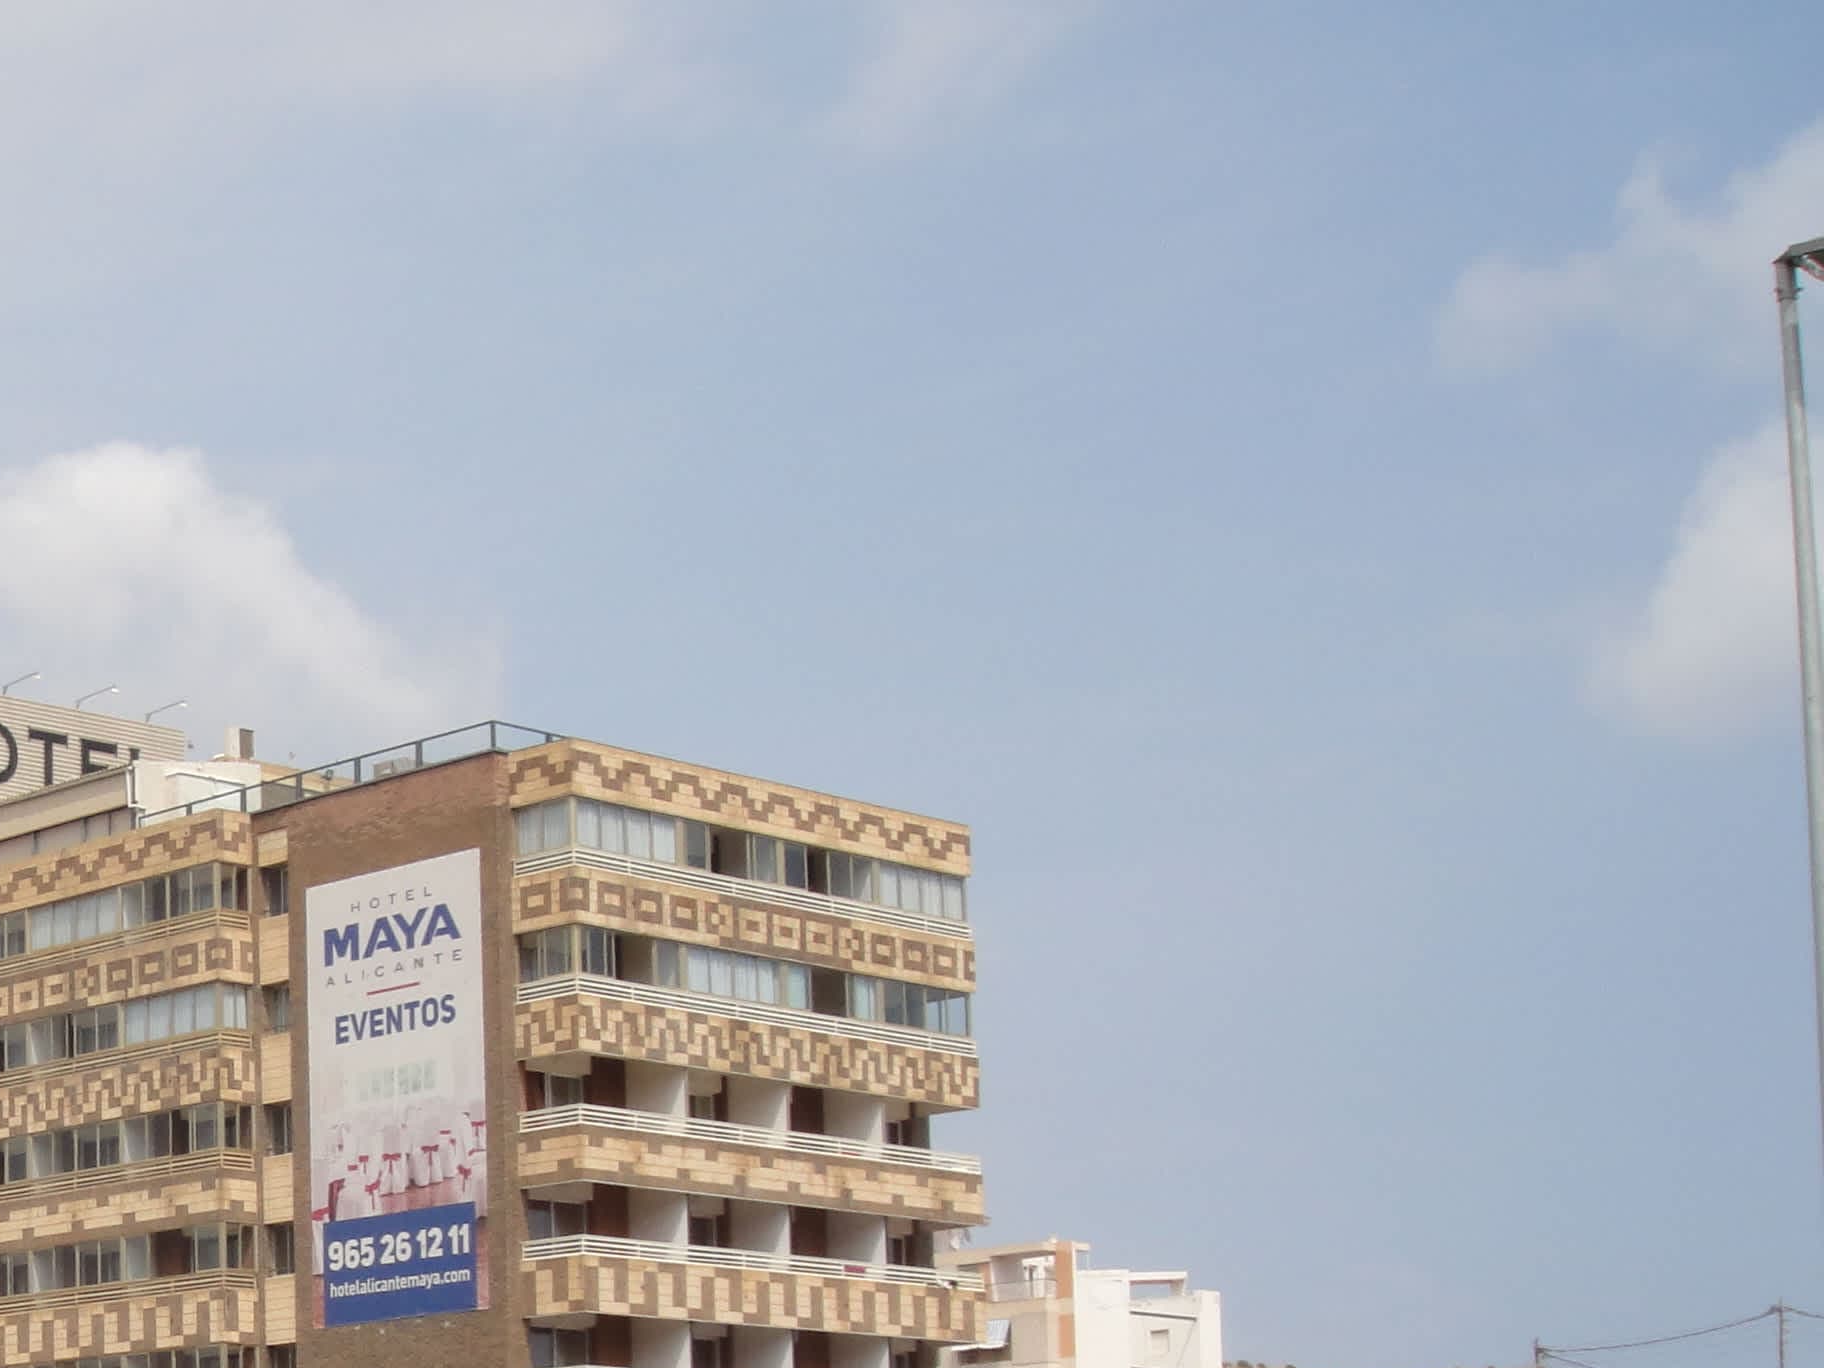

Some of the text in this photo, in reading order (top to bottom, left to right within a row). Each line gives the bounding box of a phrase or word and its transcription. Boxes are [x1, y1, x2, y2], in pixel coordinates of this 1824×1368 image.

[350, 885, 433, 913] HOTEL
[323, 903, 462, 967] MAYA
[325, 948, 463, 988] ALICANTE
[335, 994, 456, 1045] EVENTOS
[328, 1223, 471, 1272] 965 26 12 11
[329, 1267, 471, 1300] hotelalicantemaya.com
